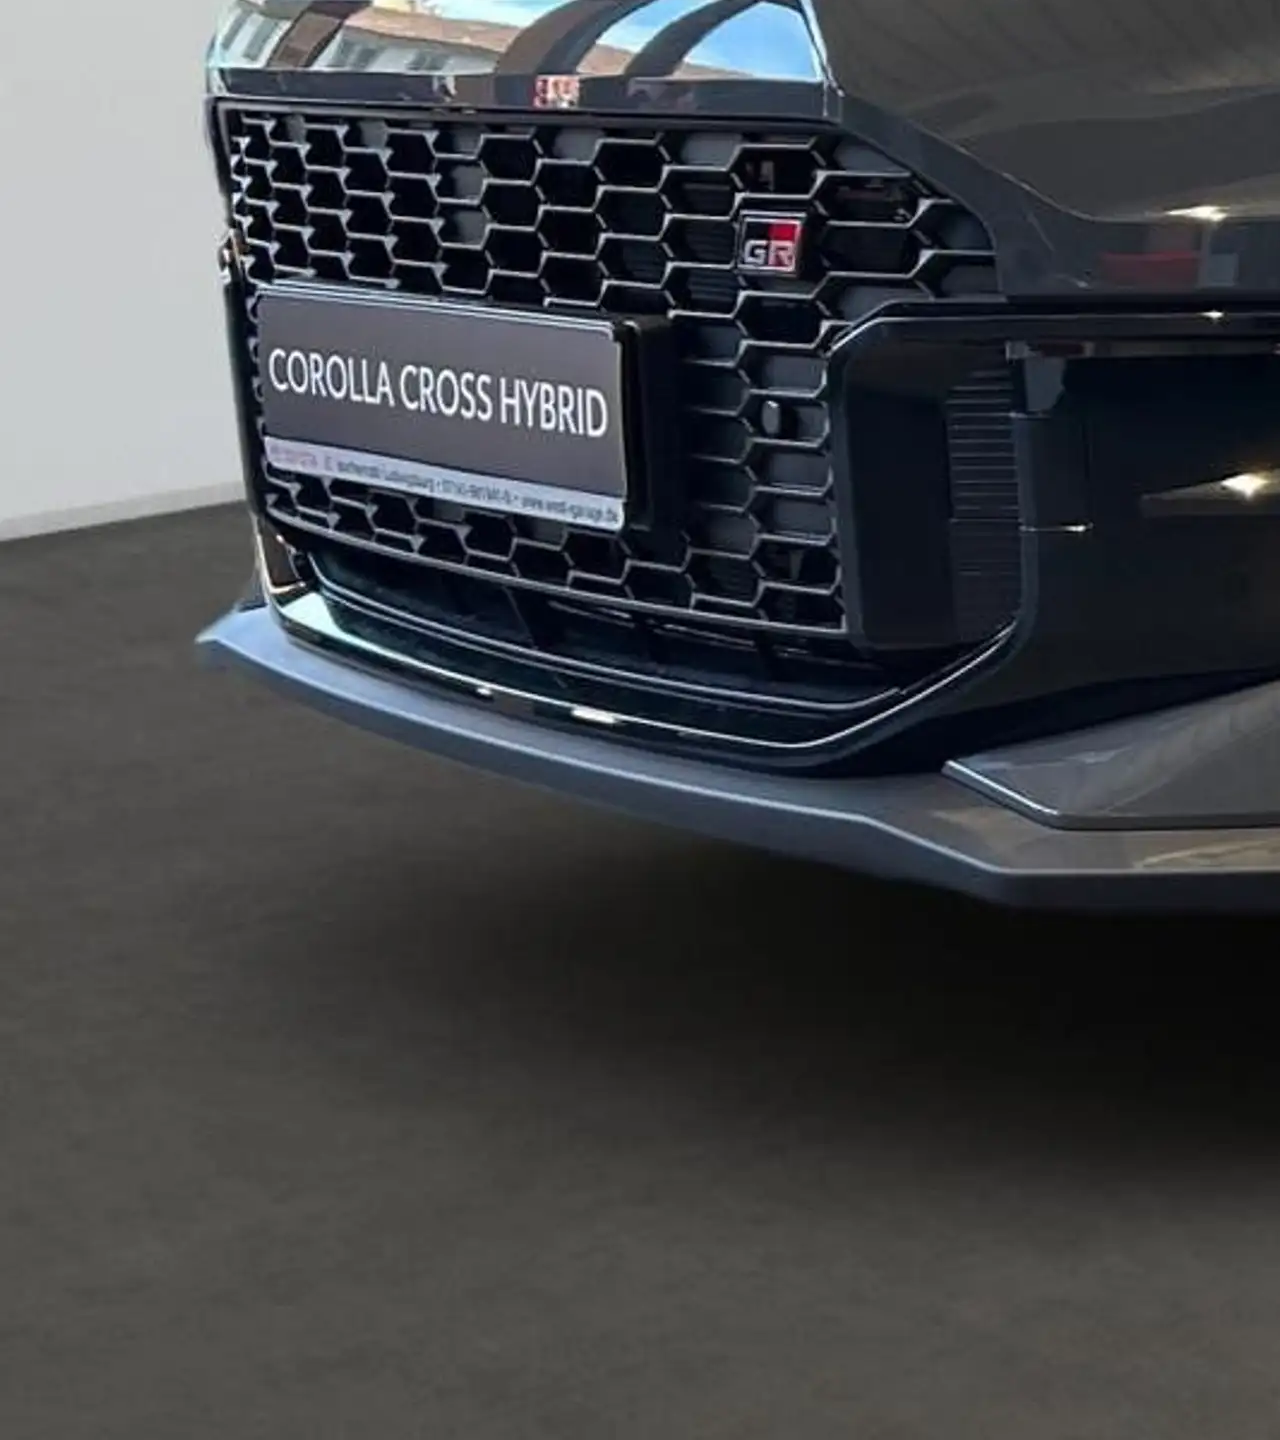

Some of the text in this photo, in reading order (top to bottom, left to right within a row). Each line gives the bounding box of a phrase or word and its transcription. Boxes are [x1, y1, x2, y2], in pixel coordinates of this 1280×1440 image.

[743, 239, 796, 267] GR
[267, 347, 608, 438] COROLLA CROSS HYBRID
